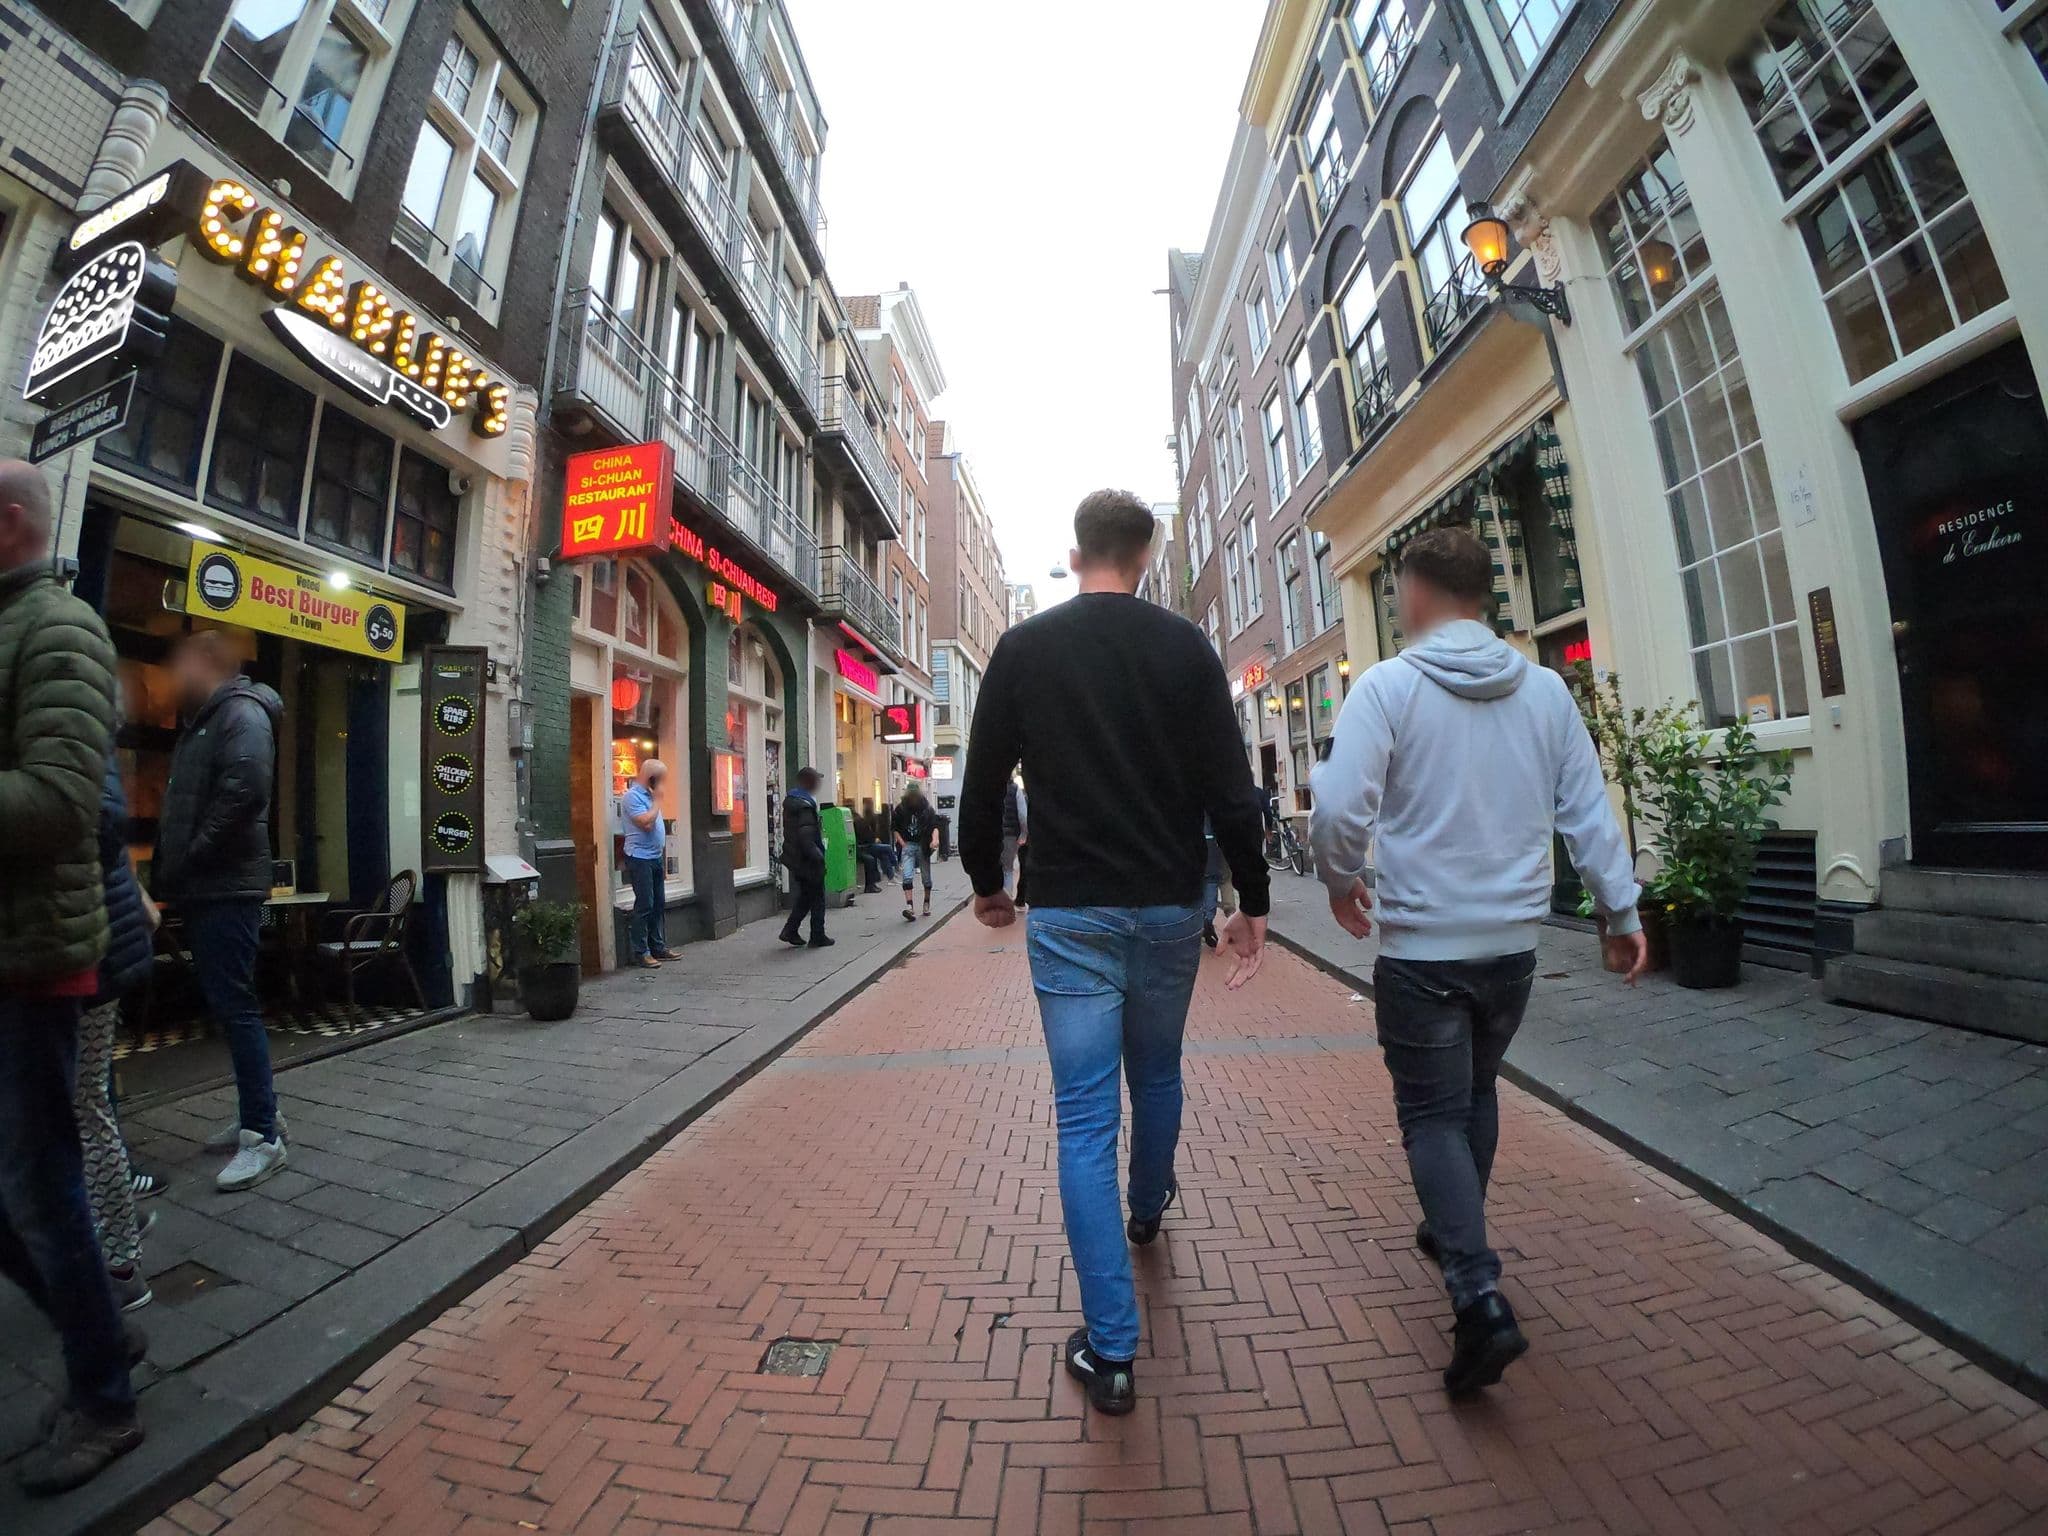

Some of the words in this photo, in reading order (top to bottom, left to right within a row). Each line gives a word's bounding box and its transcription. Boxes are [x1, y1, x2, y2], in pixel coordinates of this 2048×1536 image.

[197, 178, 509, 437] CHARLIE'S
[313, 330, 382, 388] ITCHEN
[593, 455, 632, 470] CHINA
[581, 469, 642, 488] SI-CHUAN
[568, 482, 654, 506] RESTAURANT
[1938, 500, 2014, 535] RESIDENCE
[1943, 543, 1956, 564] de
[296, 574, 320, 592] Voted
[709, 547, 754, 597] SI-CHUAN
[756, 582, 777, 612] REST
[250, 576, 294, 609] Best
[299, 591, 360, 626] Burger
[300, 615, 322, 632] Town
[443, 706, 468, 717] SPARE
[443, 713, 464, 724] RIBS
[436, 765, 471, 778] CHICKEN
[439, 773, 465, 784] FILLET
[438, 826, 469, 839] BURGER
